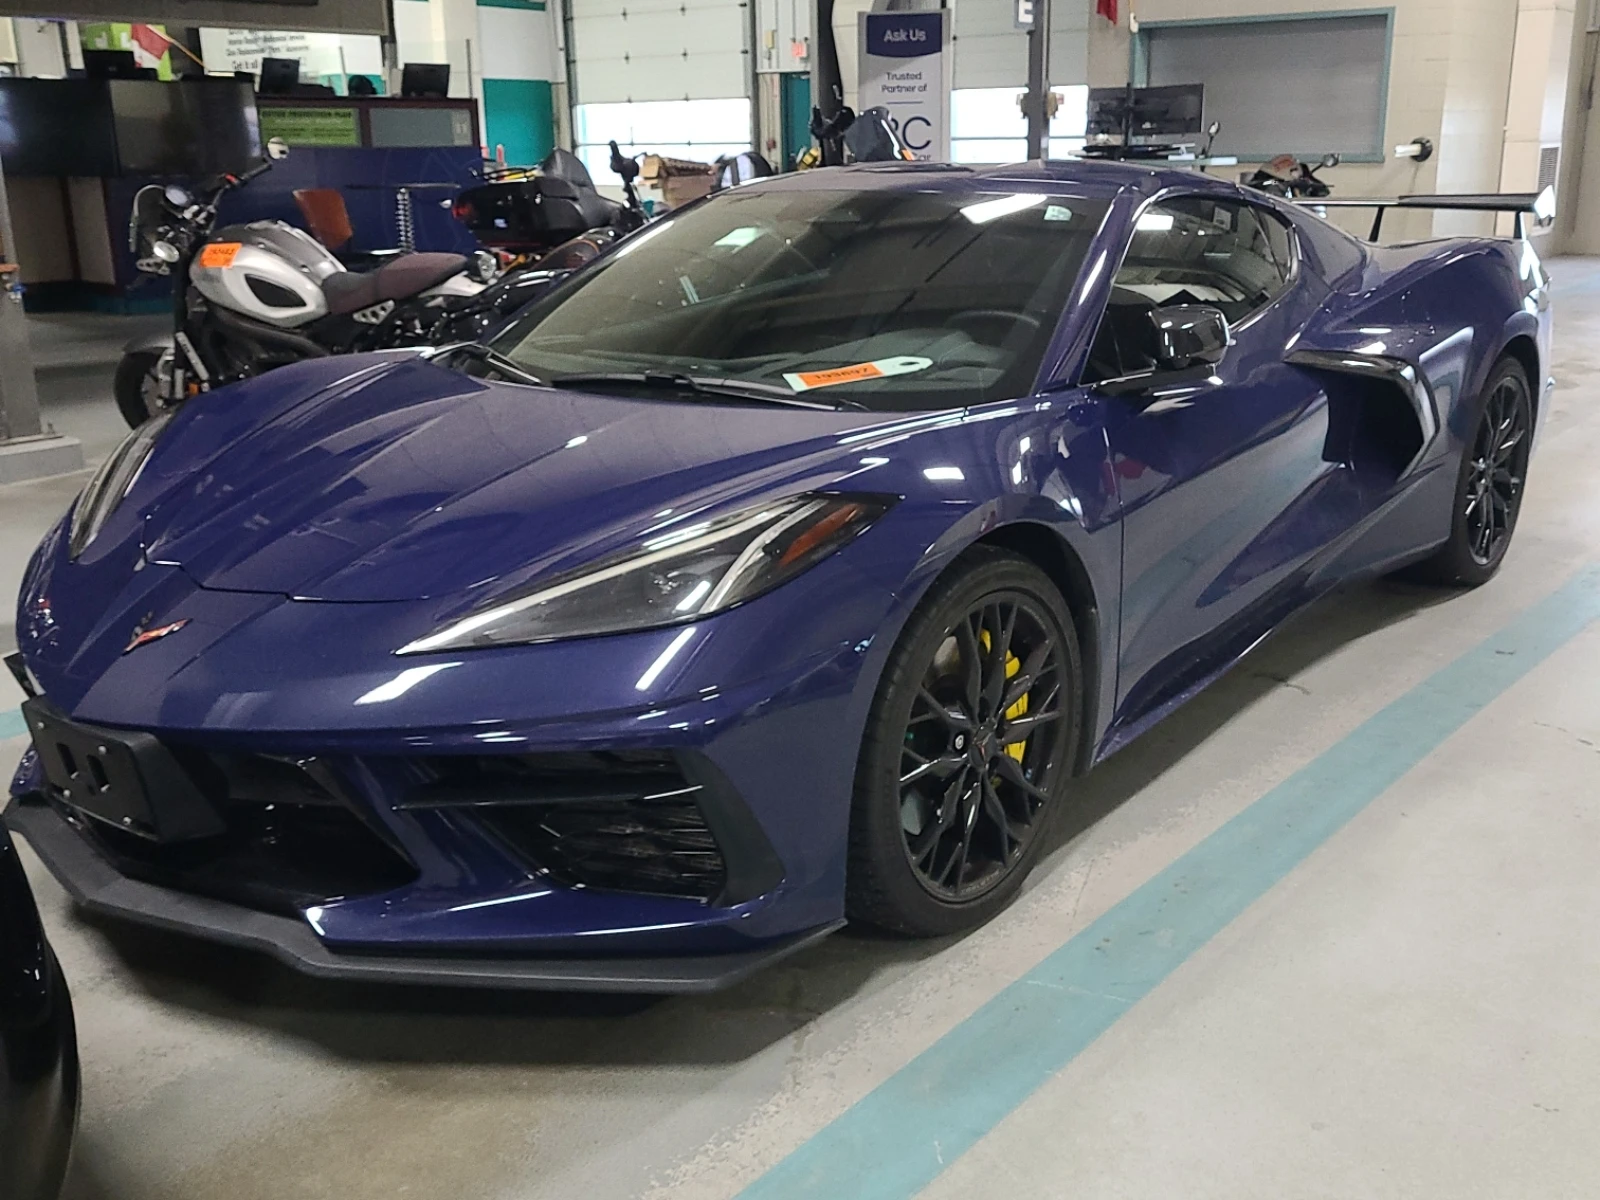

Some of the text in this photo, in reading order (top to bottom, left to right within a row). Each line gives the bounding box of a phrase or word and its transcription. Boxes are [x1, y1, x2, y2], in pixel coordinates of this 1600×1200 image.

[884, 28, 926, 42] Ask Us
[886, 72, 922, 80] Trusted
[881, 83, 927, 93] Partner of
